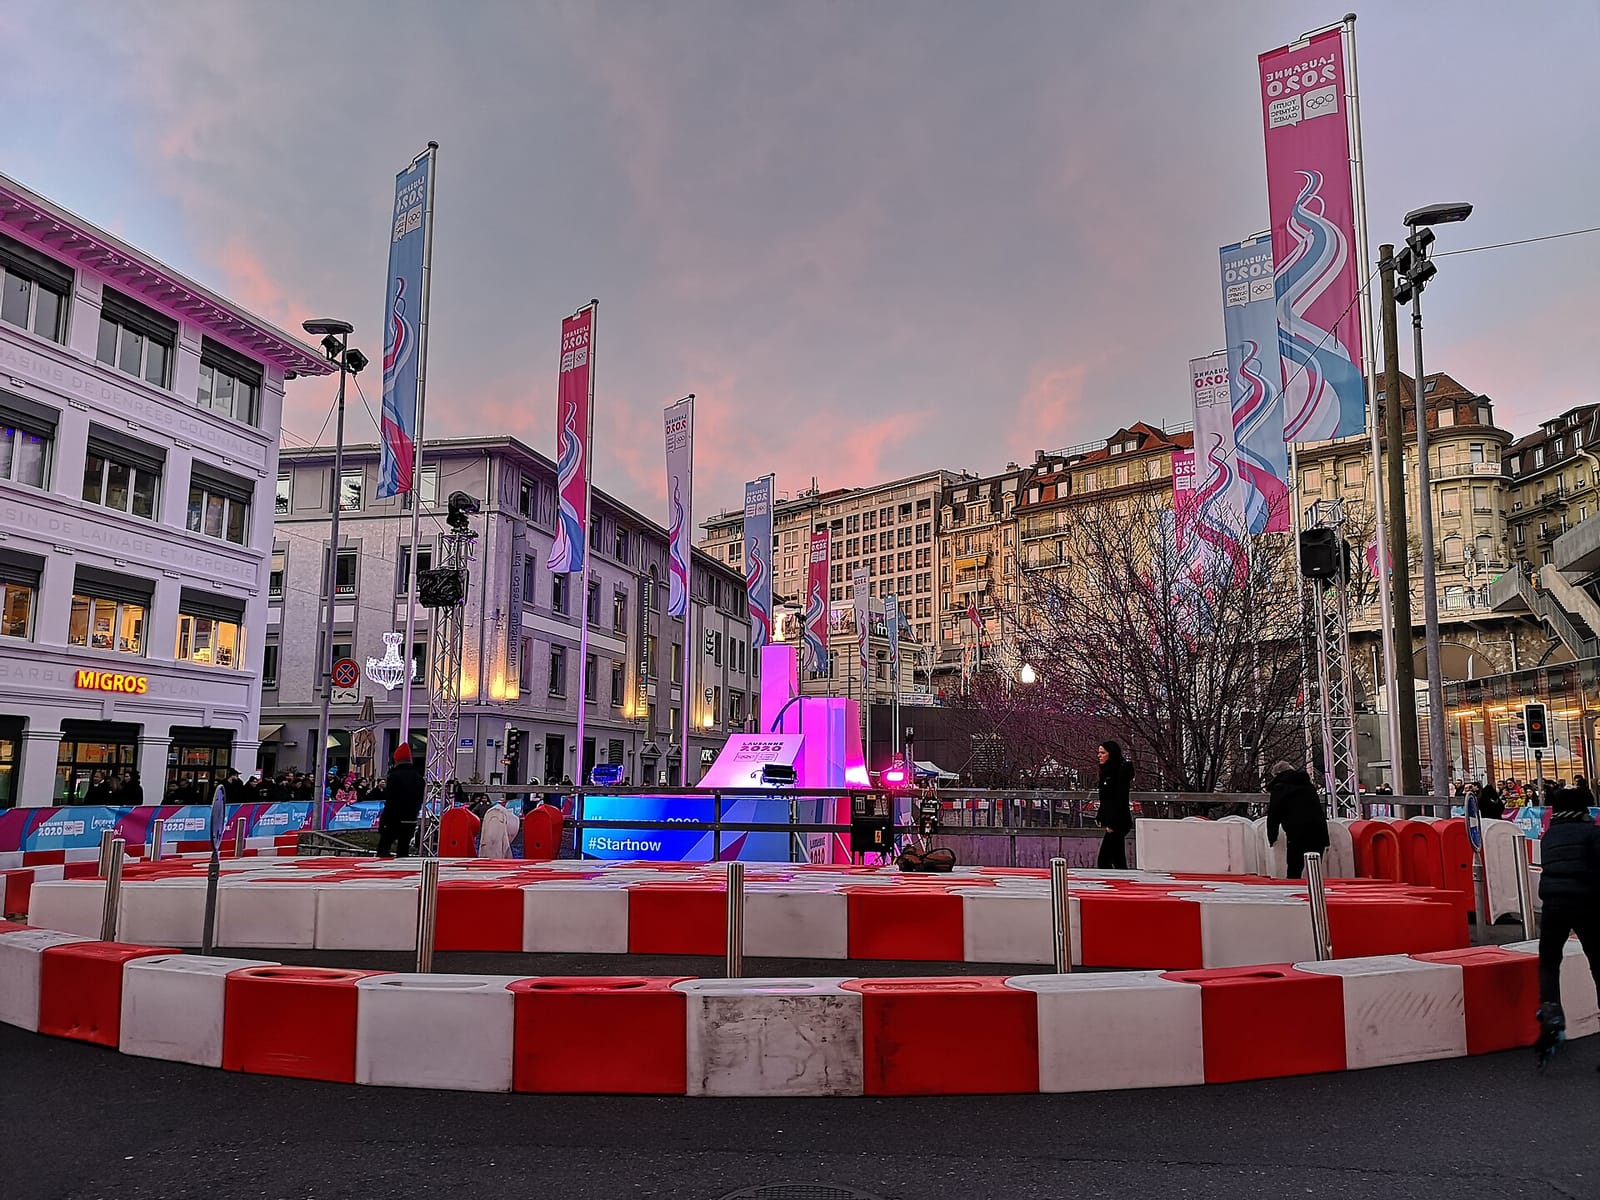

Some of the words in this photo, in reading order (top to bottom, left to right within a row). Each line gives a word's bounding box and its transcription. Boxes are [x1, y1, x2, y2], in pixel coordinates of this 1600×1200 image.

[72, 376, 94, 394] DE
[5, 507, 39, 525] SIN
[49, 518, 73, 534] DE
[81, 526, 153, 554] LAINAGE
[160, 546, 178, 558] ET
[184, 551, 253, 579] MERCERIE
[512, 550, 521, 567] bar
[512, 576, 521, 603] resto
[876, 622, 888, 636] fn
[705, 628, 714, 657] KFC
[77, 669, 148, 694] MIGROS
[701, 749, 713, 761] KFC
[37, 826, 63, 837] 2020
[588, 836, 662, 852] #Startnow
